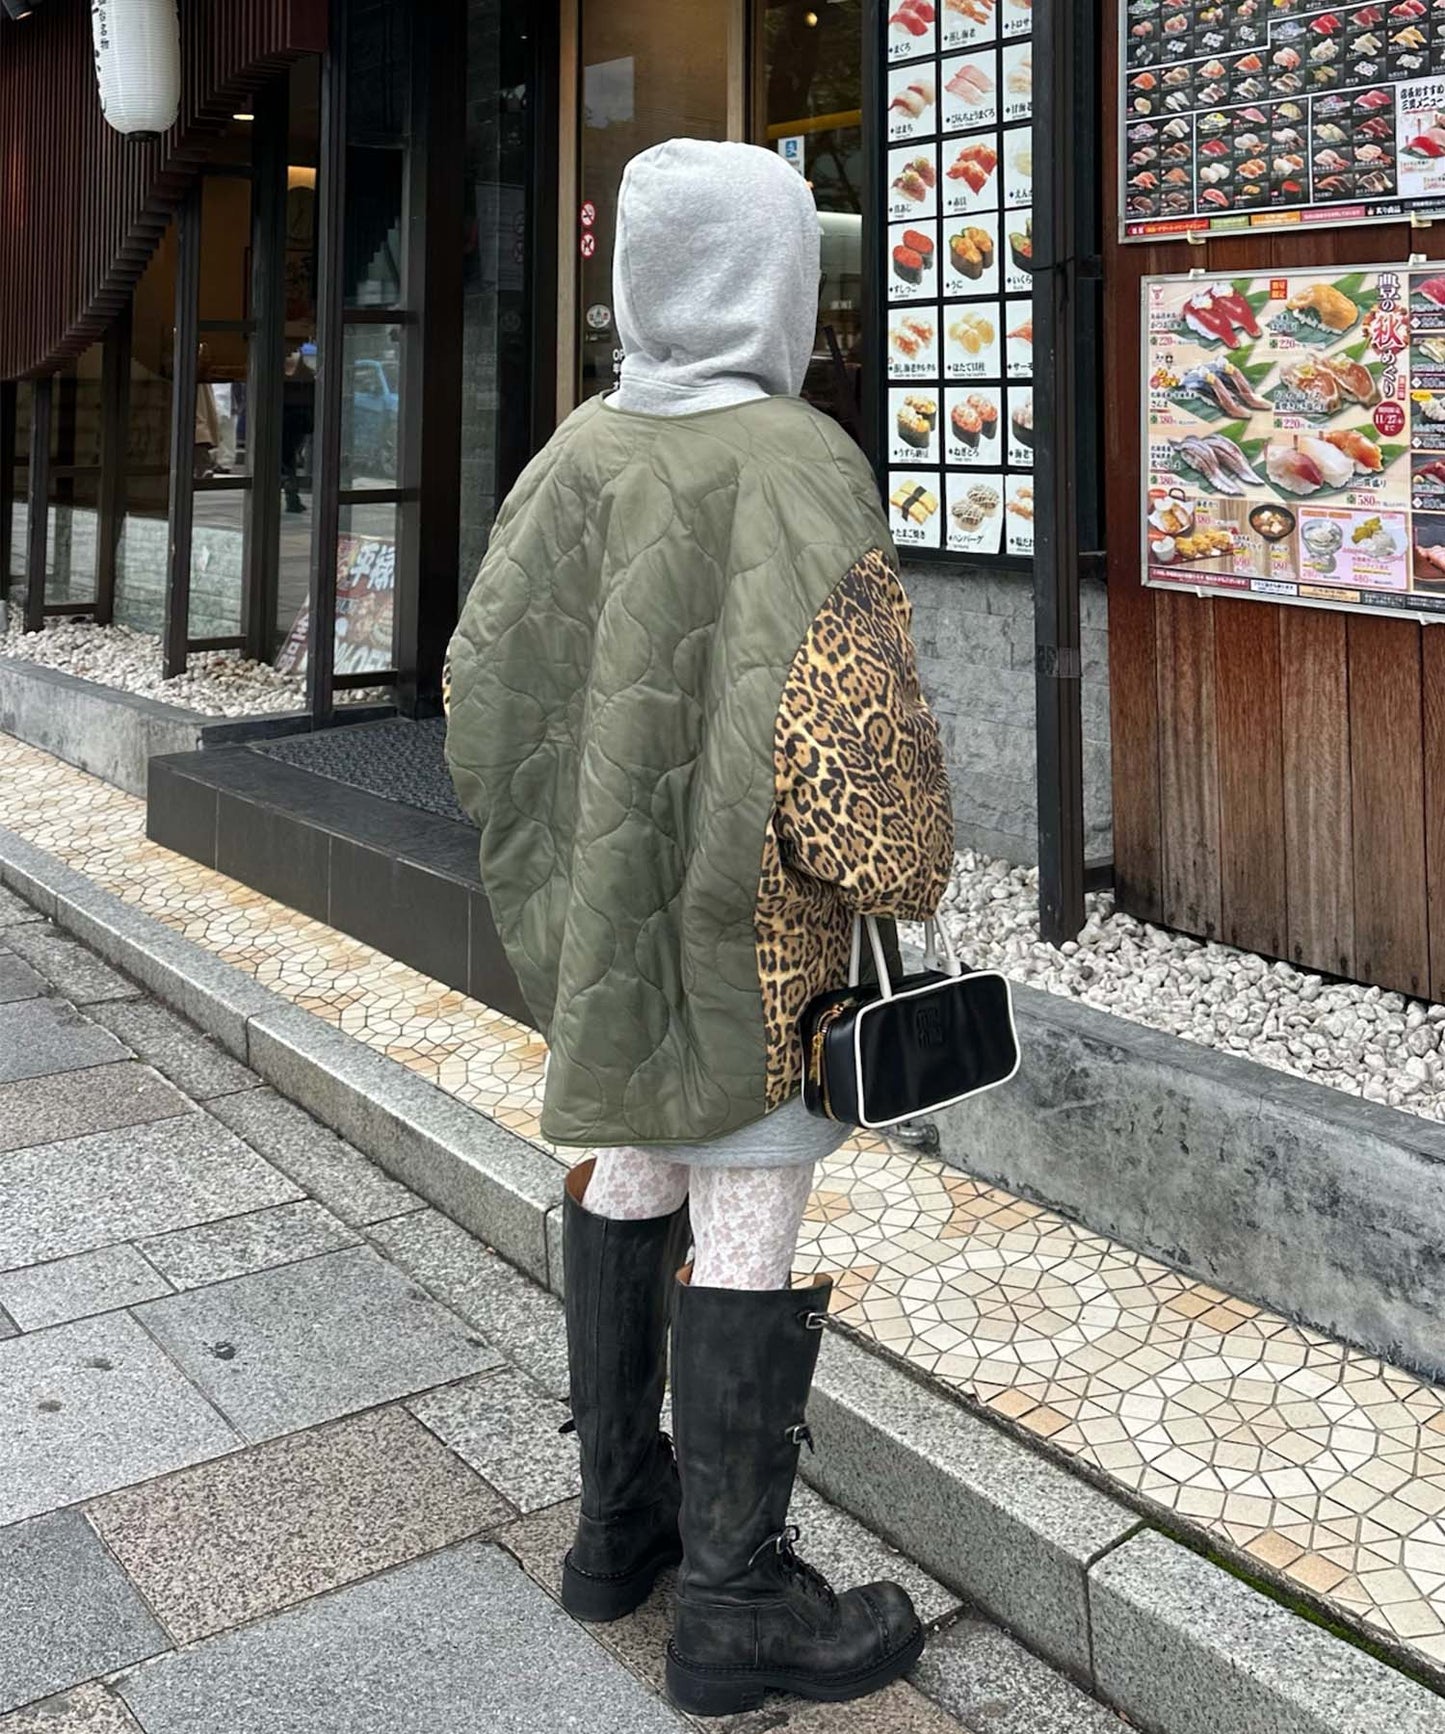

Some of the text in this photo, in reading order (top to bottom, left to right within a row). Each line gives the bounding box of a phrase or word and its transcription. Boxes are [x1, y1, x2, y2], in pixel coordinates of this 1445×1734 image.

[894, 42, 911, 54] まぐろ
[895, 124, 913, 134] はまち
[951, 280, 963, 289] うに
[1371, 271, 1406, 398] 豊の秋めぐり
[953, 447, 979, 457] ねぎとろ
[896, 528, 926, 540] たまご焼き
[953, 534, 984, 545] ハンバーグ
